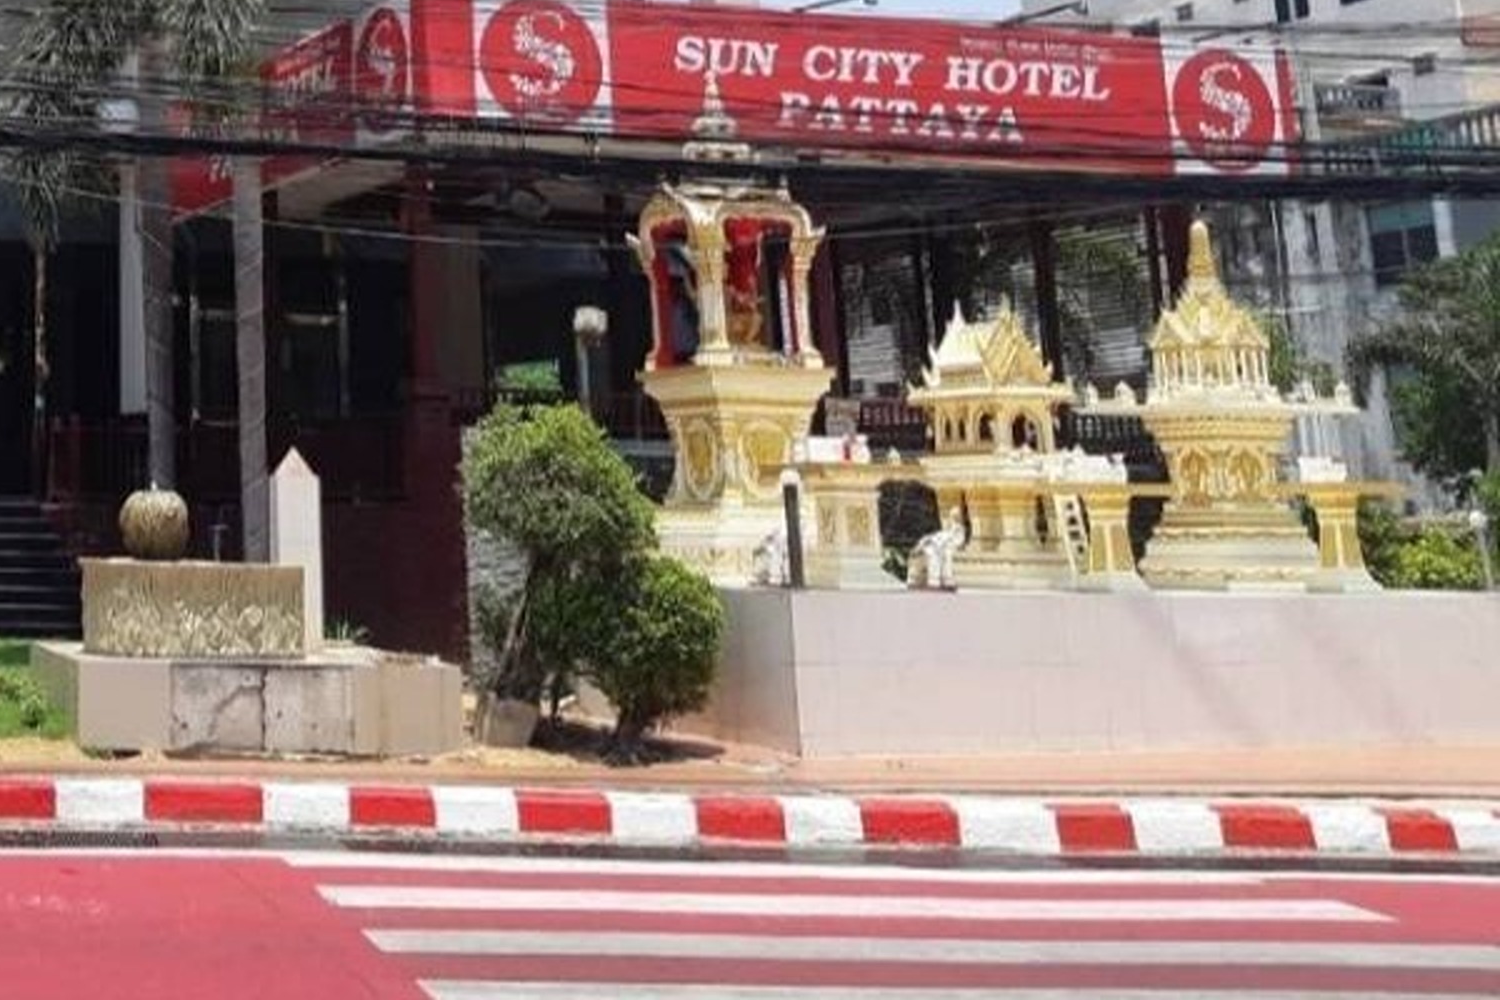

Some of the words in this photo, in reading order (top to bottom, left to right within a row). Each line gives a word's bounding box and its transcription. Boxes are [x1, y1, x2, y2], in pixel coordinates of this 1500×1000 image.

[674, 35, 778, 77] SUN
[803, 45, 924, 86] CITY
[944, 56, 1111, 101] HOTEL
[777, 91, 1024, 142] PATTAYA
